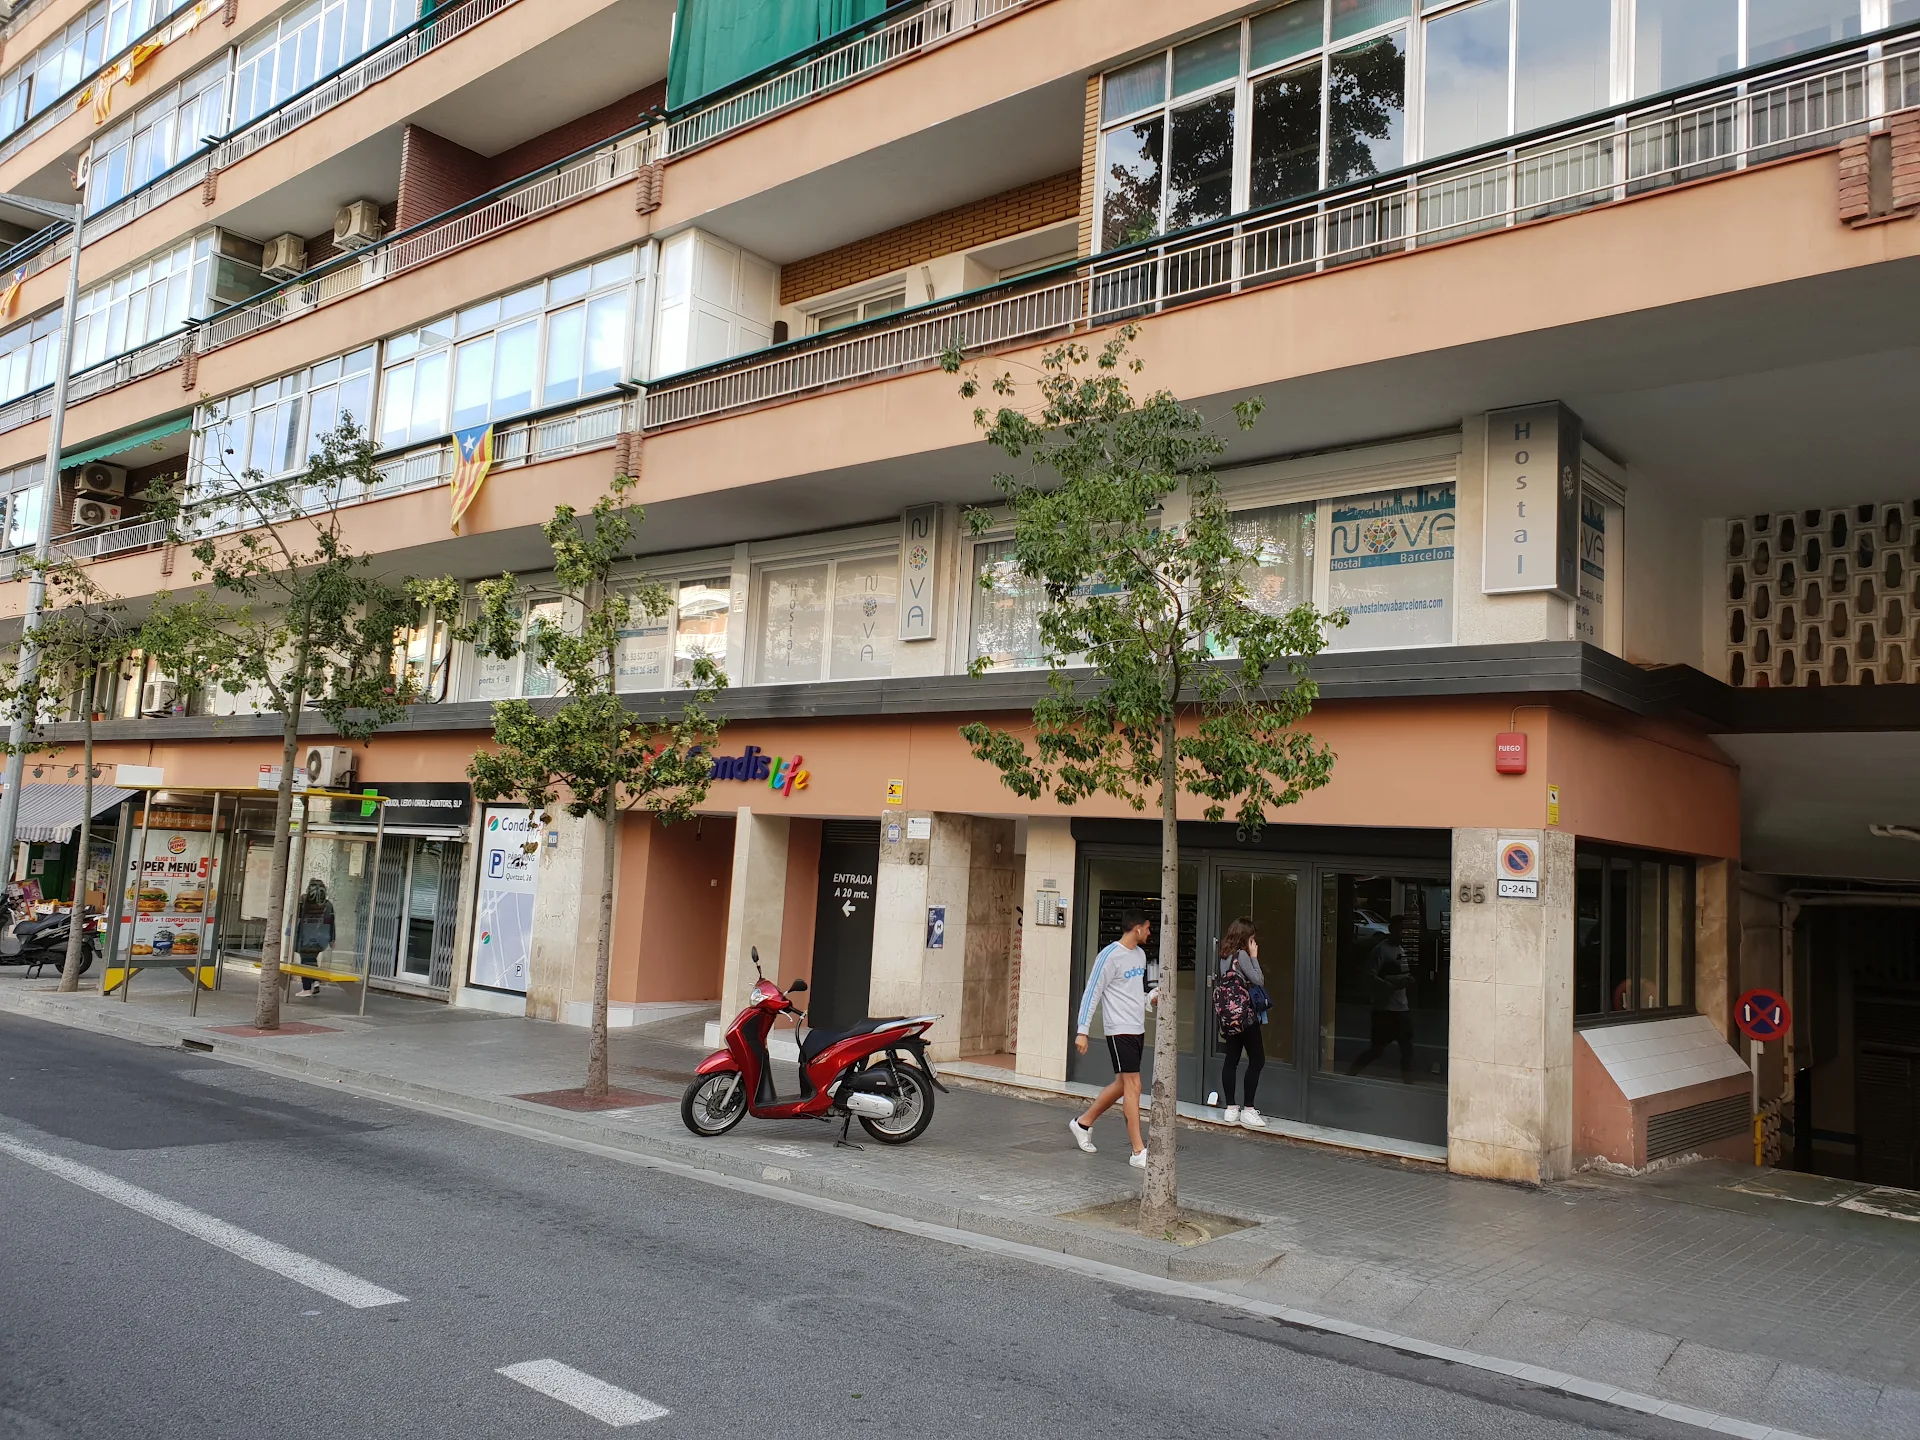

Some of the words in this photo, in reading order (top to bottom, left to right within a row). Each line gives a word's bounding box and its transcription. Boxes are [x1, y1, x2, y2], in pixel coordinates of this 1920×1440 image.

[1513, 421, 1531, 575] Hostal
[1331, 557, 1361, 570] Hostal
[768, 755, 811, 797] life
[909, 852, 924, 865] 65
[130, 860, 165, 872] SPER
[167, 860, 198, 873] MENÚ
[833, 873, 873, 885] ENTRADA
[834, 889, 841, 897] A
[841, 887, 853, 899] 20
[853, 890, 870, 899] mts.
[1459, 883, 1486, 904] 65
